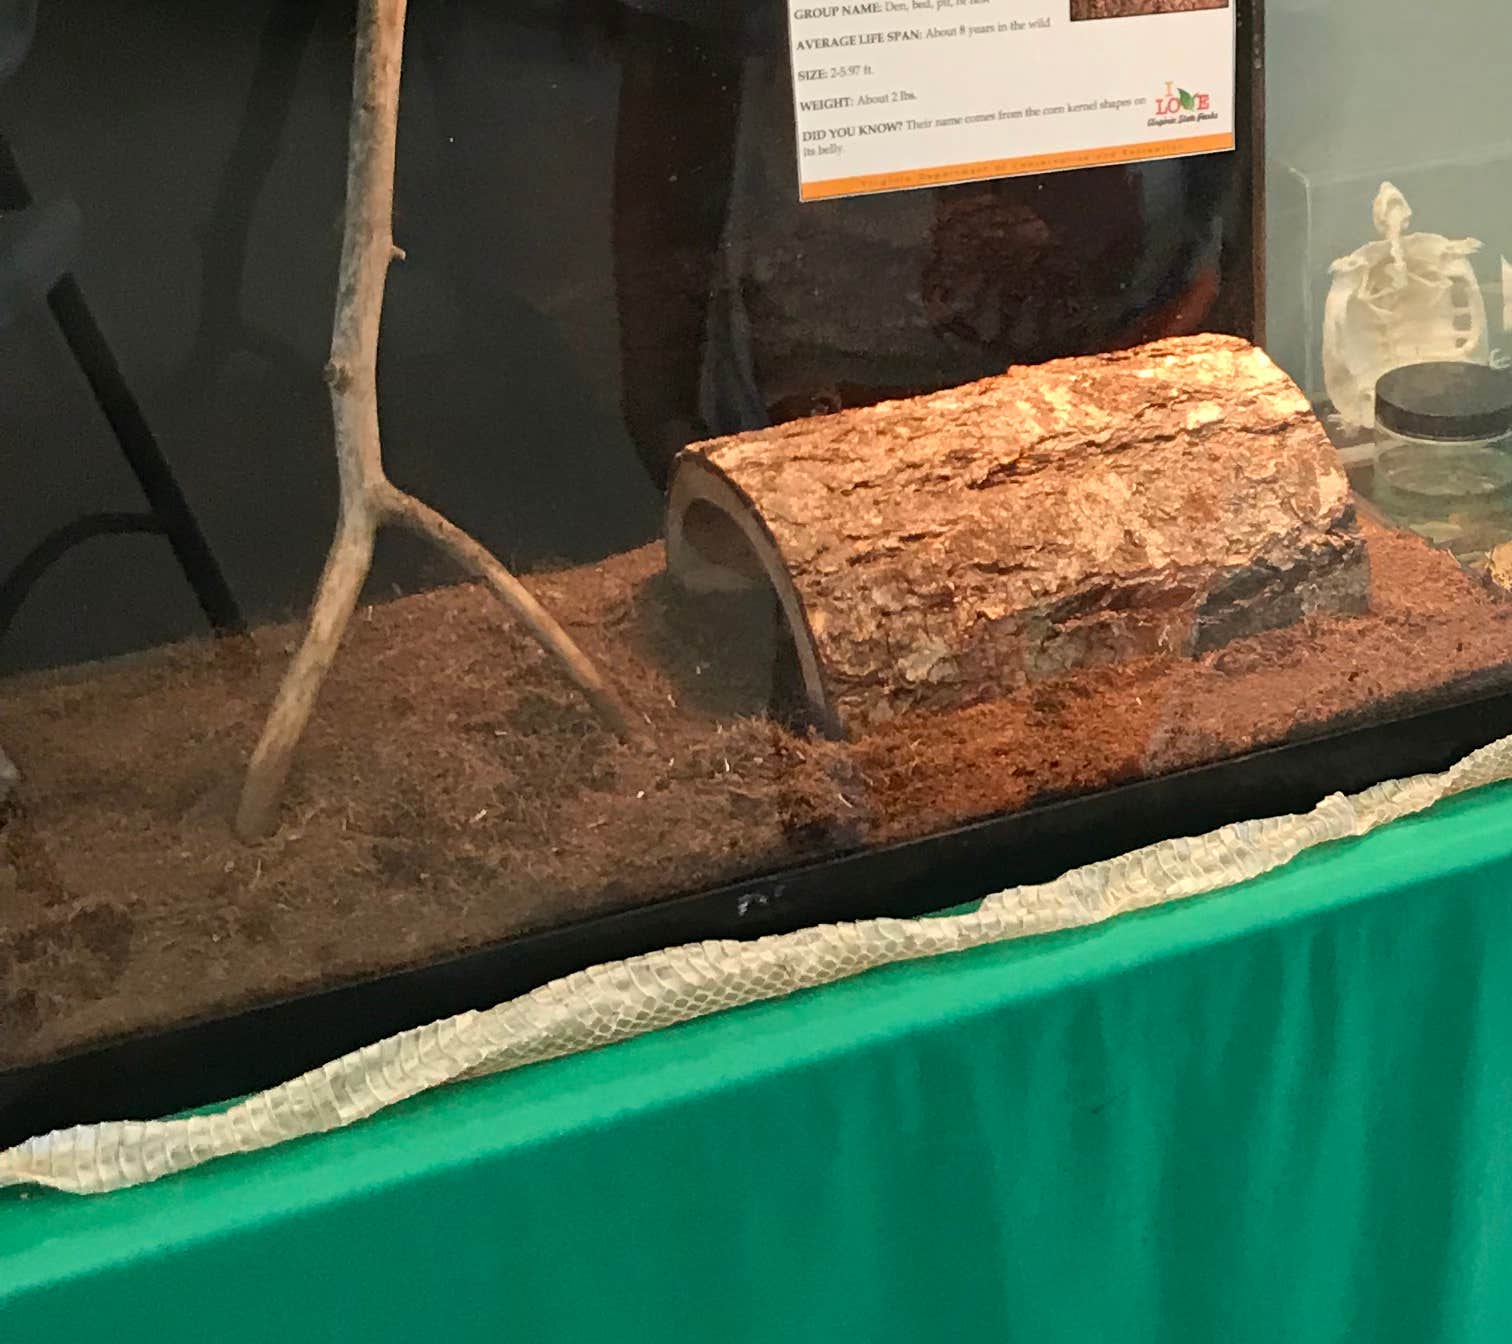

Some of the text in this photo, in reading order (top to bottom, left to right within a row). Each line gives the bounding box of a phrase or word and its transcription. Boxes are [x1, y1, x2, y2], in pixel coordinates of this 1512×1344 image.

[794, 5, 840, 20] GROUP
[796, 35, 857, 51] AVERAGE
[858, 32, 885, 46] LIFE
[887, 29, 922, 43] SPAN:
[926, 26, 957, 39] About
[968, 23, 995, 38] years
[997, 21, 1008, 32] in
[1010, 20, 1026, 31] the
[1028, 16, 1051, 29] wild
[798, 68, 828, 82] SIZE:
[800, 97, 855, 112] WEIGHT:
[857, 94, 889, 106] About
[891, 91, 898, 102] 2
[802, 129, 827, 142] DID
[829, 126, 856, 139] YOU
[858, 121, 903, 136] KNOW?
[906, 119, 933, 131] Their
[998, 109, 1023, 121] from
[1025, 106, 1041, 117] the
[1042, 105, 1065, 117] corn
[1067, 100, 1098, 114] kernel
[1099, 98, 1132, 112] shapes
[803, 146, 815, 158] its
